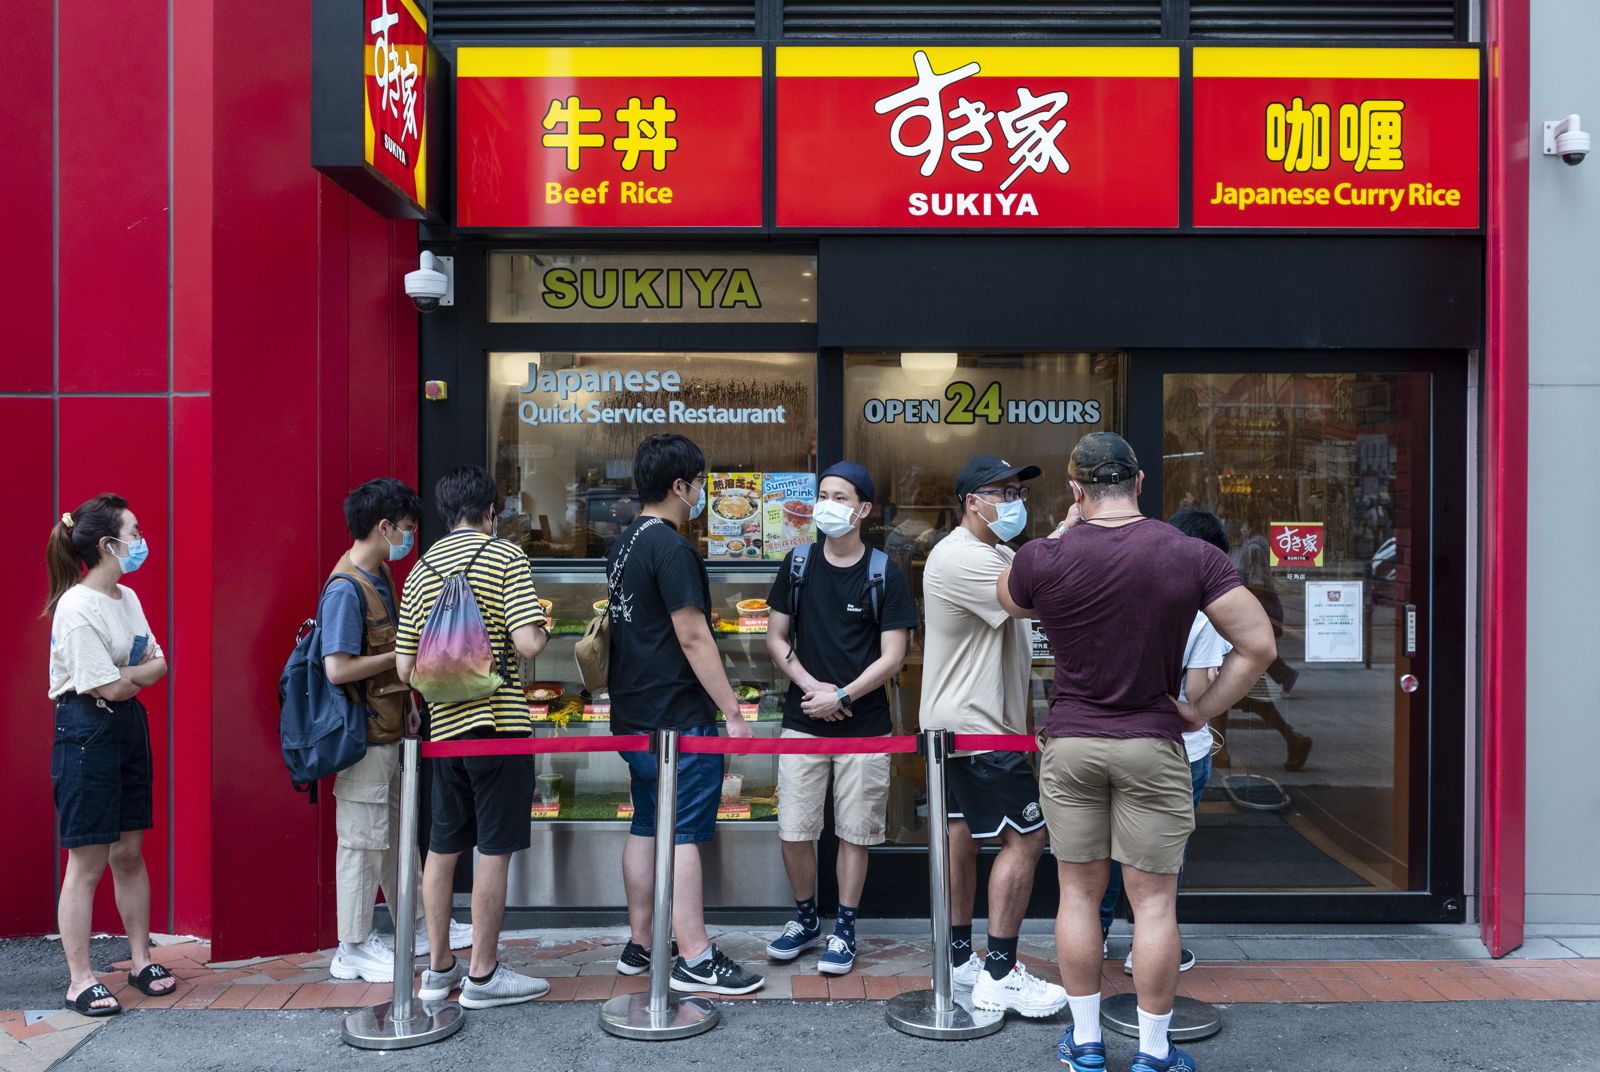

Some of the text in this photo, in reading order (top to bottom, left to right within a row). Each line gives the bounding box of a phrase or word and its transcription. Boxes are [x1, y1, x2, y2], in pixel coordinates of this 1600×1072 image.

[541, 95, 679, 172] 牛丼
[874, 50, 1070, 191] すき家
[1265, 96, 1405, 174] 咖喱
[384, 133, 407, 166] SUKIYA
[545, 181, 673, 204] Beef Rice
[908, 193, 1039, 217] SUKIYA
[1210, 181, 1461, 212] Japanese Curry Rice
[541, 267, 762, 310] SUKIYA
[519, 362, 682, 399] Japanese
[518, 400, 786, 426] Quick Service Restaurant
[863, 381, 1102, 424] OPEN 24 HOURS
[765, 477, 809, 492] Summer
[786, 488, 814, 498] Drink
[1276, 526, 1318, 555] すき家
